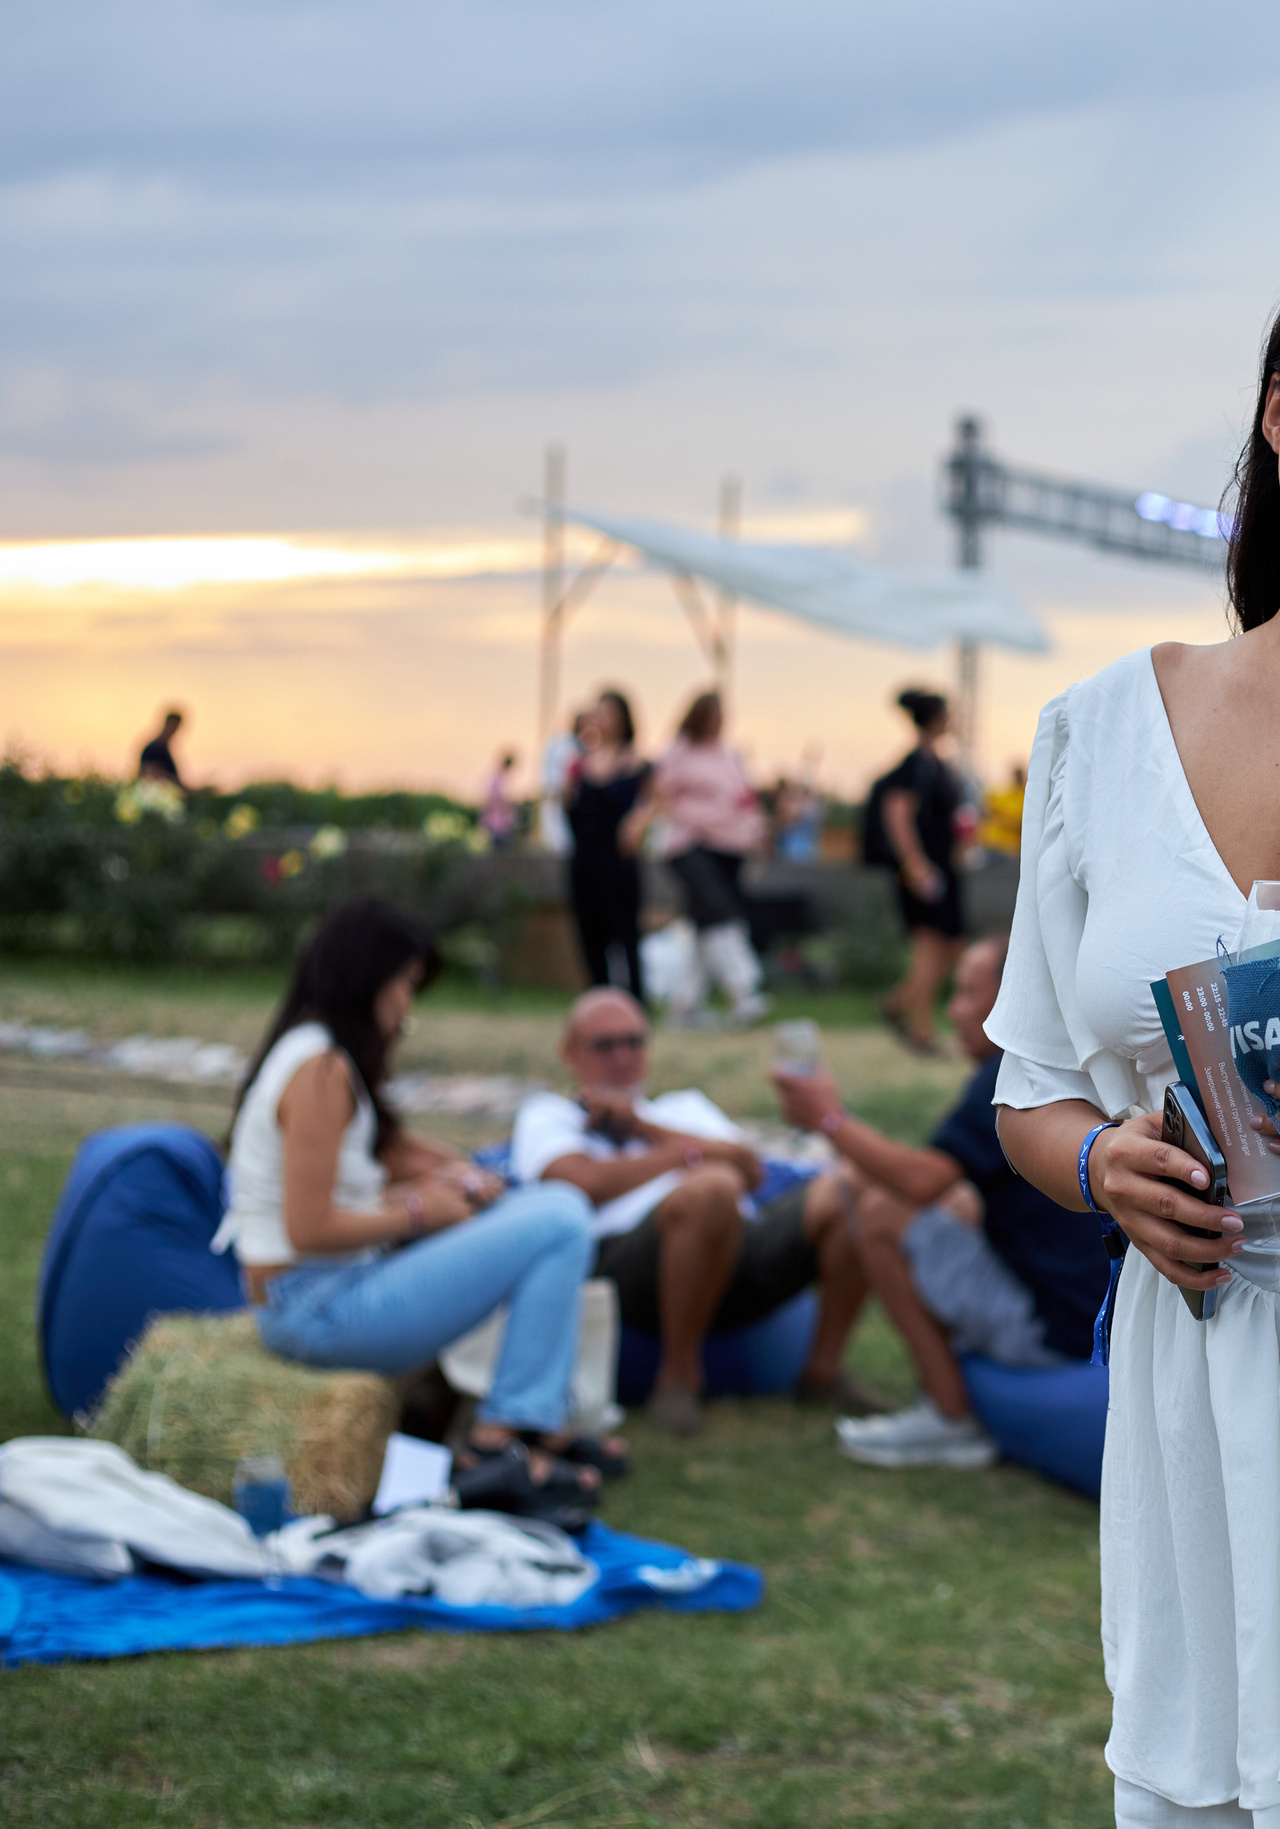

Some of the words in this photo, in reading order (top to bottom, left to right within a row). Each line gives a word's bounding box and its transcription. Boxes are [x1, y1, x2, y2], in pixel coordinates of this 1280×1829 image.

[1182, 990, 1194, 1011] 00:00
[1204, 1065, 1222, 1109] Завершение
[1216, 1108, 1233, 1147] праздника
[1196, 986, 1208, 1007] 23:00
[1203, 1011, 1215, 1032] 00:00
[1218, 1061, 1236, 1108] Выступление
[1232, 1107, 1244, 1133] группы
[1239, 1132, 1252, 1157] Zangar
[1210, 982, 1222, 1003] 22:15
[1218, 1007, 1228, 1028] 22:45
[1232, 1060, 1251, 1104] упление
[1254, 1130, 1267, 1158] erbolat
